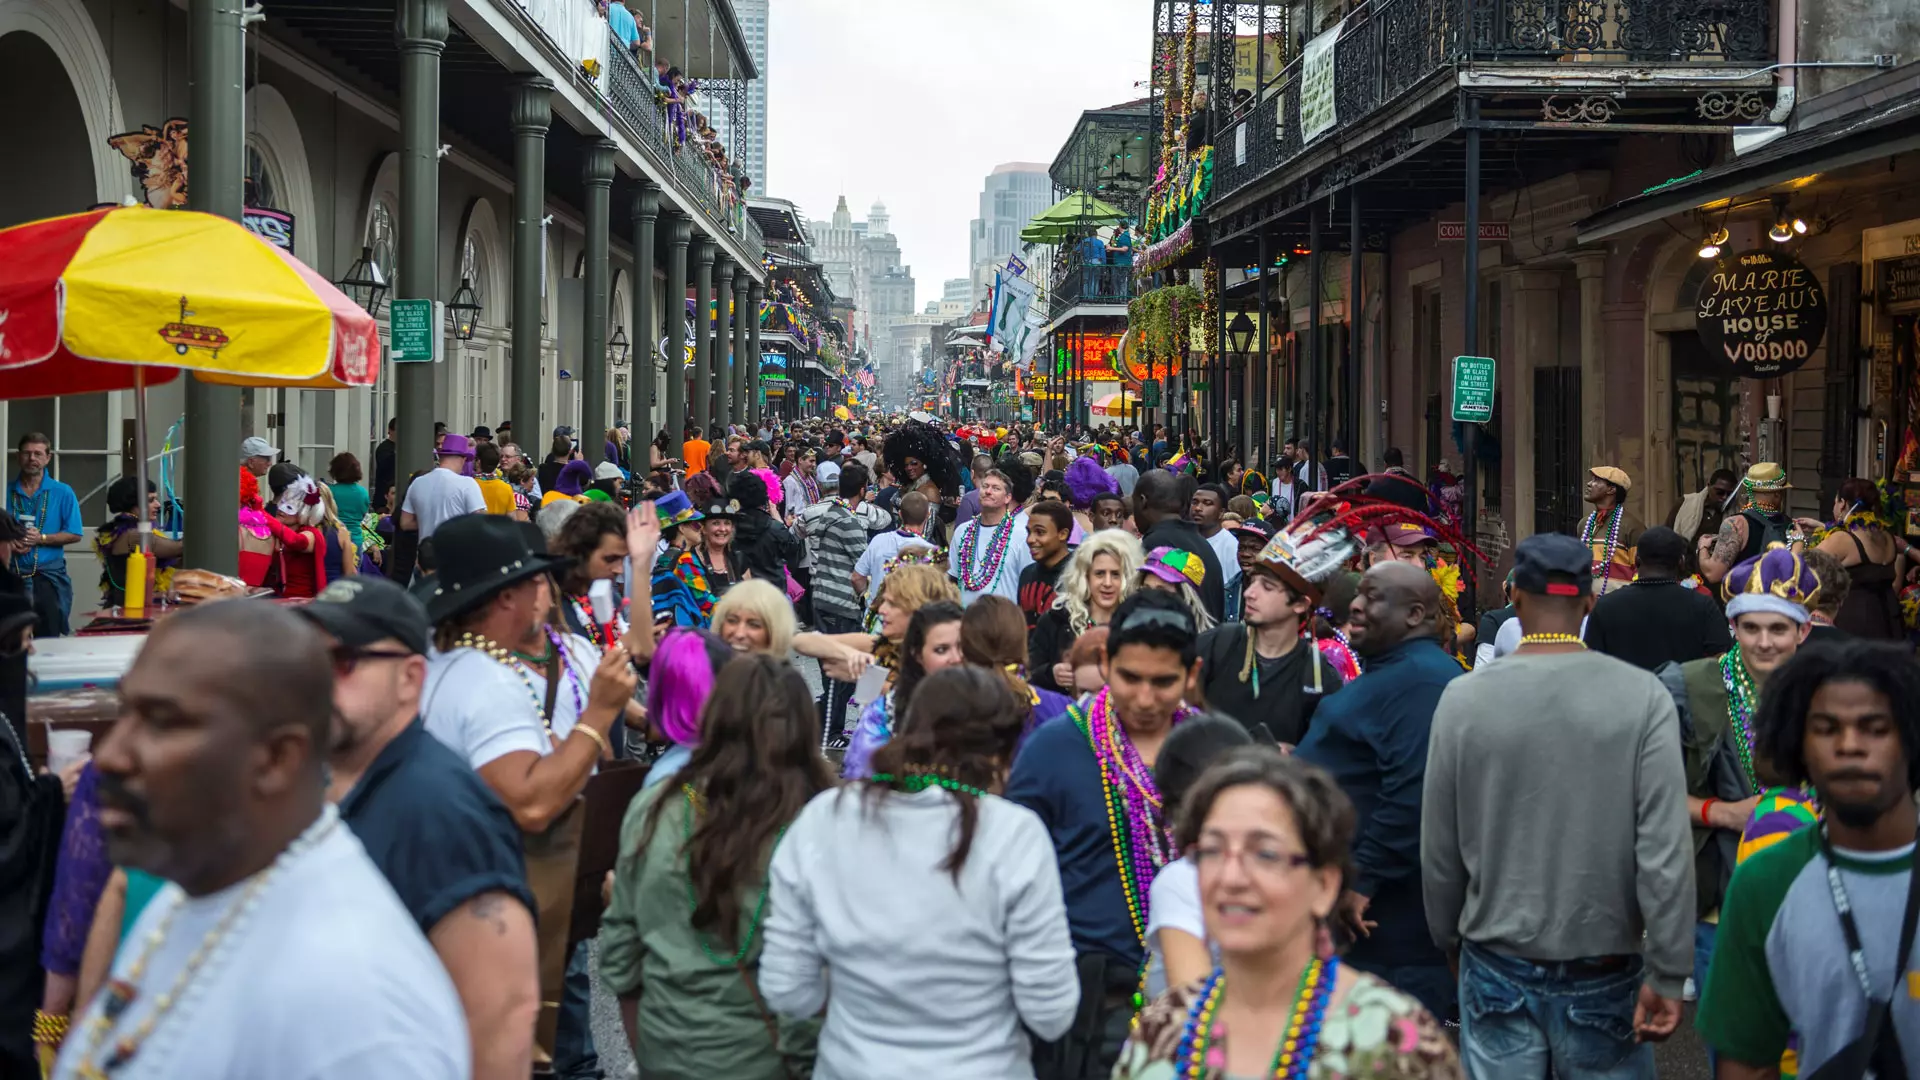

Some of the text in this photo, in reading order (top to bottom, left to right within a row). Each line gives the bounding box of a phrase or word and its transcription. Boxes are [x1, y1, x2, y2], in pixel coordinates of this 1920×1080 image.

[1440, 226, 1508, 236] COMRCIAL
[1712, 269, 1807, 296] MARIE
[1698, 286, 1818, 318] LAVEAU'S
[1723, 314, 1799, 334] HOUSE
[1754, 328, 1774, 343] of
[1084, 350, 1102, 360] SLE
[1724, 340, 1808, 364] VOODOO
